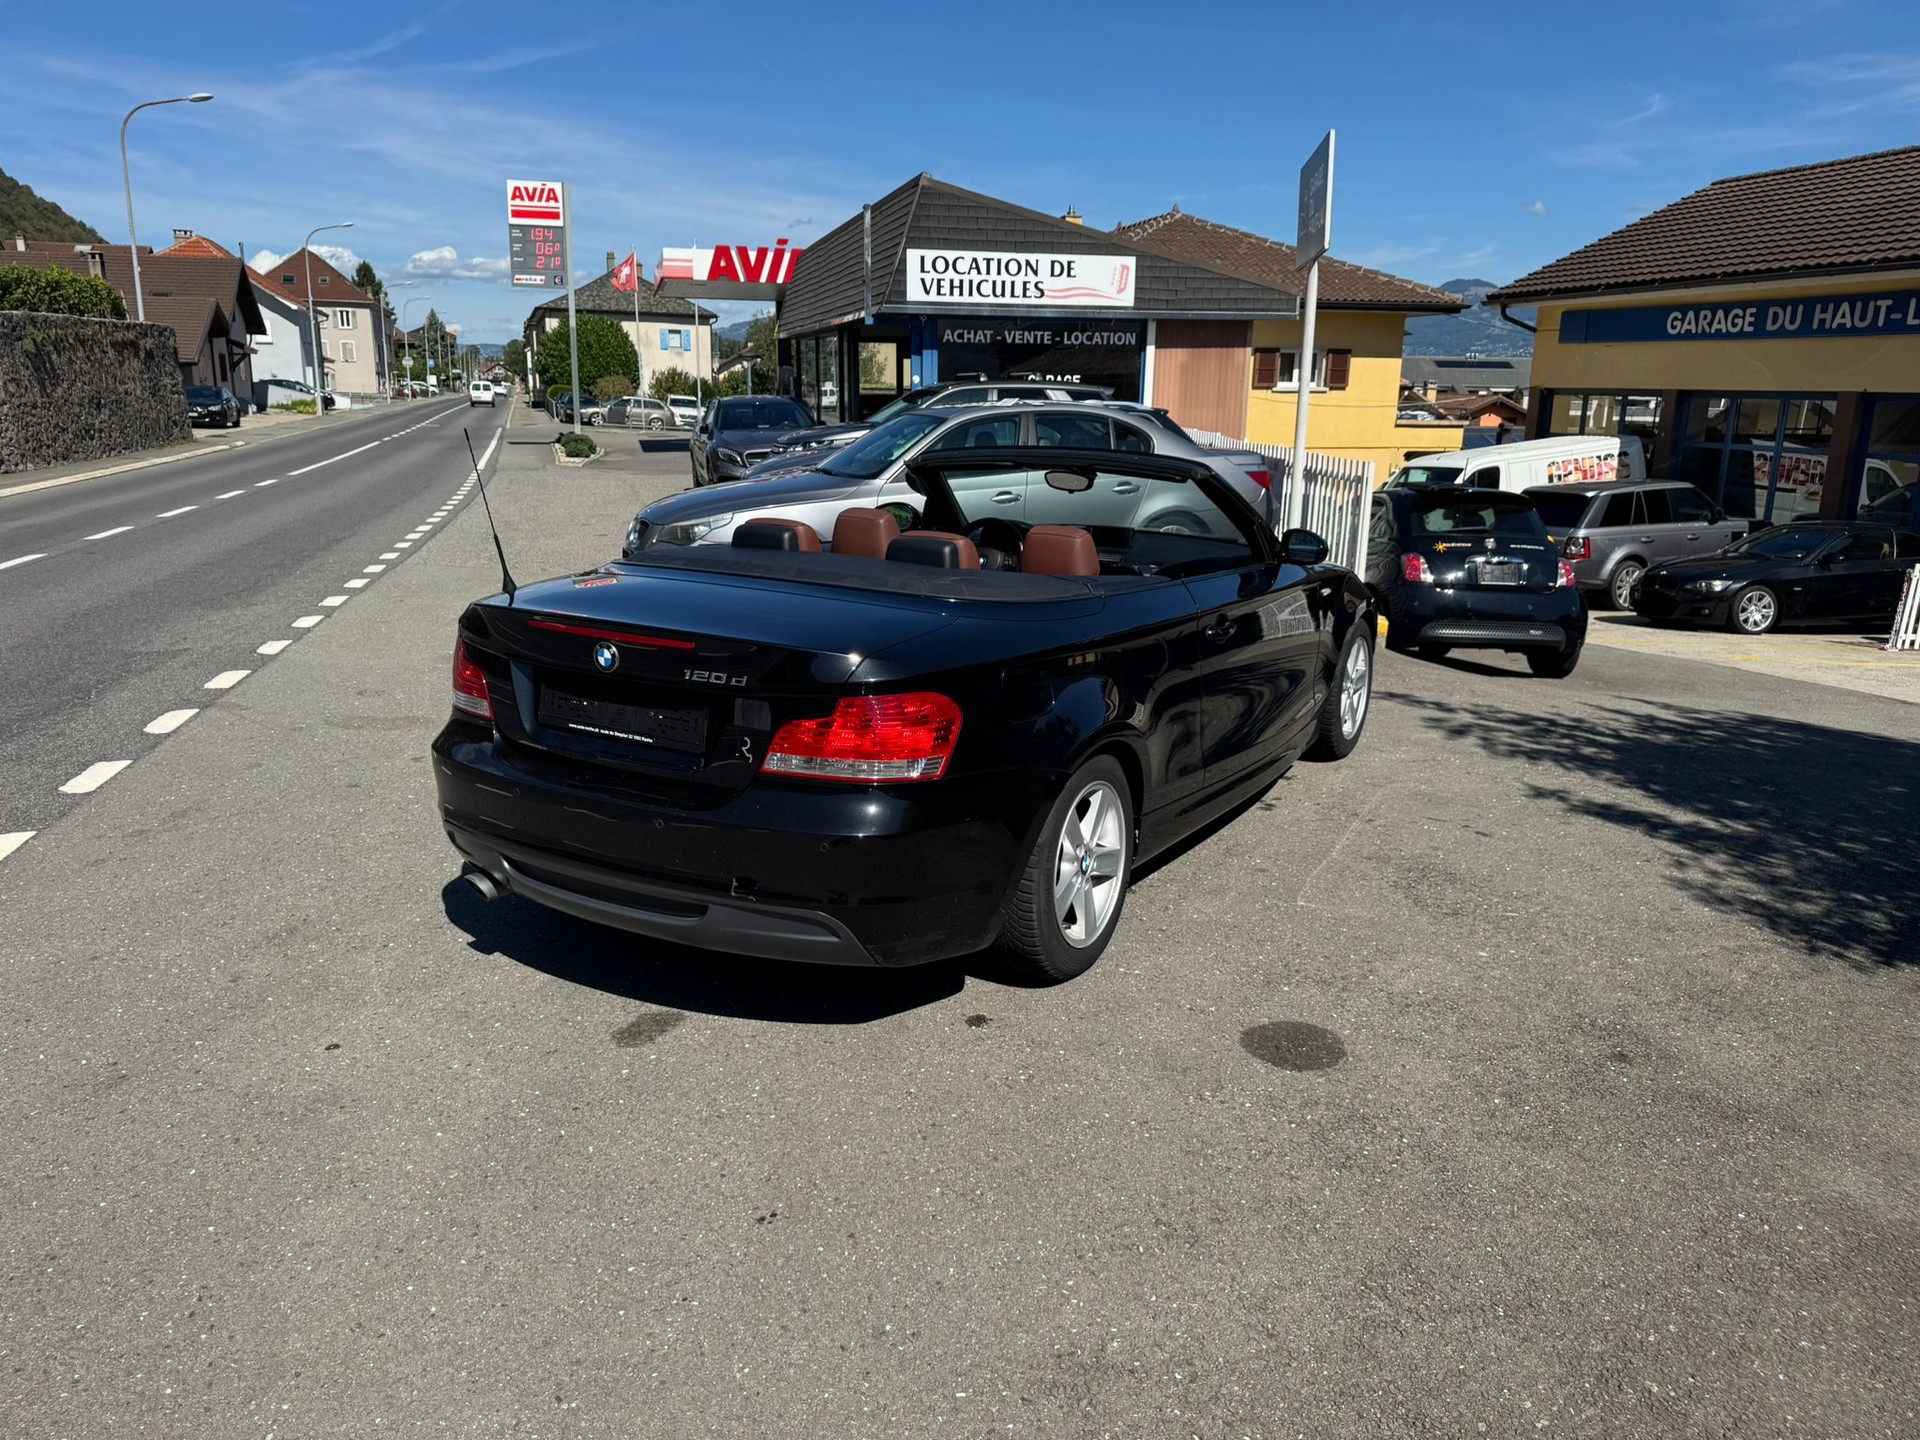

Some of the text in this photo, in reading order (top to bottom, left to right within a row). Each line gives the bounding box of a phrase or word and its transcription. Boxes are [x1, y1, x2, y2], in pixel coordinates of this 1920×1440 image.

[510, 183, 560, 203] AVIA
[919, 255, 1077, 278] LOCATION DE
[920, 278, 1045, 299] VEHICULES
[1666, 307, 1756, 335] GARAGE
[1766, 304, 1804, 331] DU
[943, 329, 993, 343] ACHAT
[1004, 330, 1052, 344] VENTE
[1063, 331, 1136, 346] LOCATION
[1027, 374, 1081, 383] GRAGE
